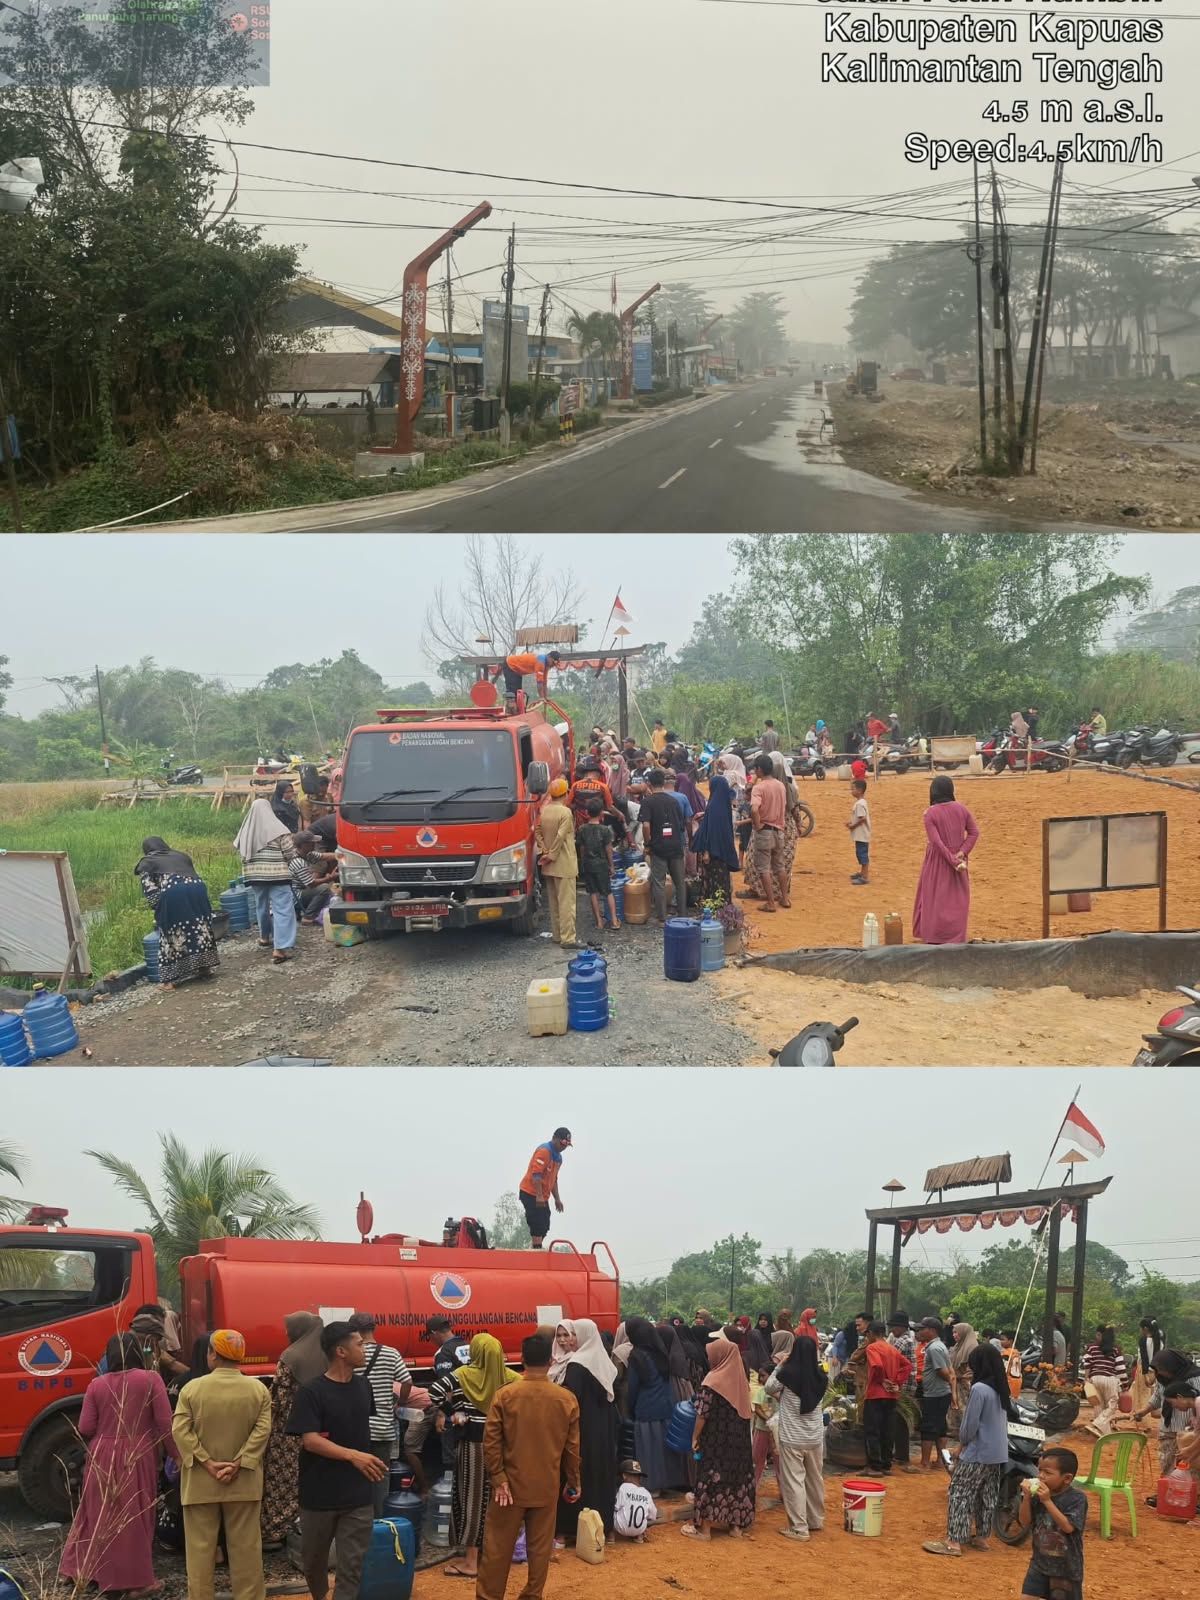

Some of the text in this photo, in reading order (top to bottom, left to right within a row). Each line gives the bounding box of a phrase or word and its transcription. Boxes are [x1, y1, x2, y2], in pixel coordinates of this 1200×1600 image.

[432, 1312, 503, 1325] ANGGULANGAN
[505, 1312, 538, 1324] BENCANA
[18, 1376, 73, 1391] BNPB
[628, 1504, 645, 1529] 10
